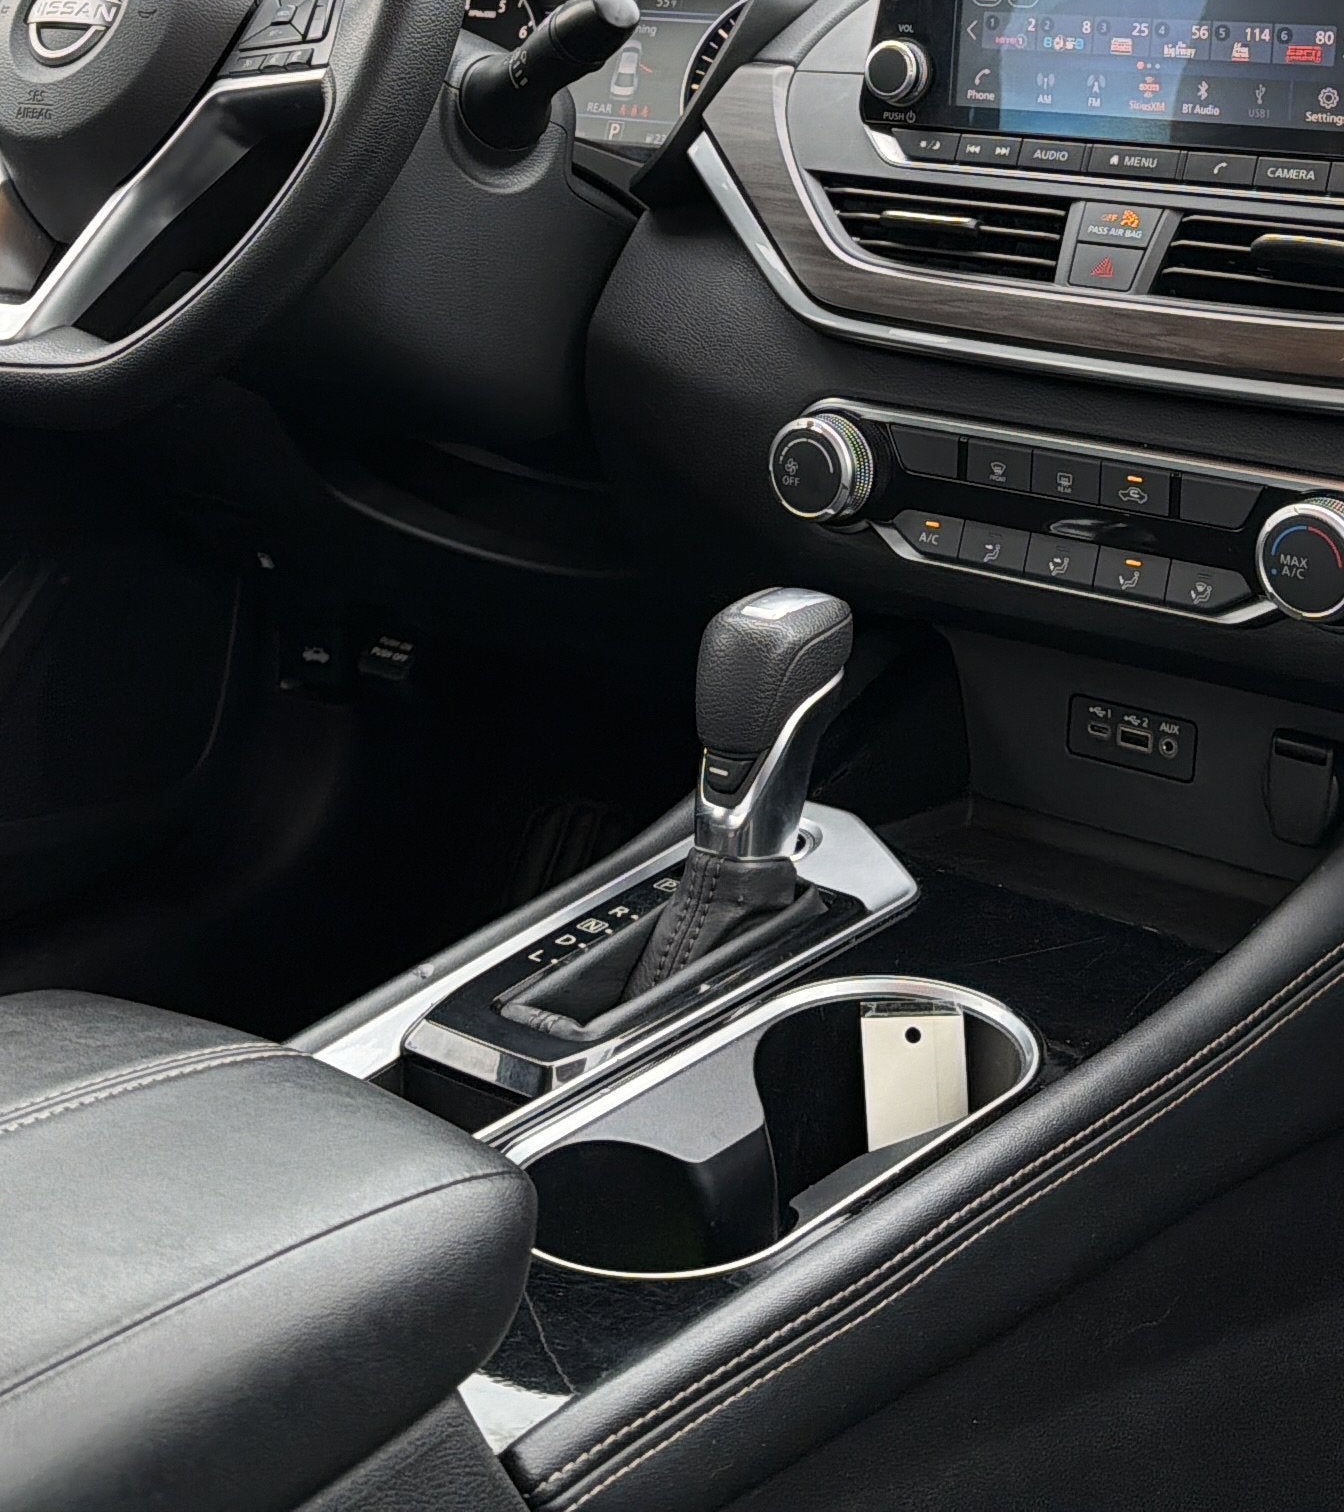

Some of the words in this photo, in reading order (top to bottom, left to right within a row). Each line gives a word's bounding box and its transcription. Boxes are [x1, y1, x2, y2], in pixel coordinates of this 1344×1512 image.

[33, 0, 117, 22] NISSAN
[498, 0, 507, 13] 5
[898, 23, 914, 34] VOL
[1027, 18, 1036, 31] 2
[1082, 20, 1092, 34] 8
[1131, 22, 1149, 37] 25
[518, 25, 528, 38] 6
[1191, 25, 1209, 39] 56
[1245, 27, 1271, 42] 114
[1316, 31, 1335, 45] 80
[967, 89, 995, 101] Phone
[1037, 94, 1052, 104] AM
[586, 102, 613, 114] REAR
[1087, 97, 1100, 107] FM
[1129, 100, 1165, 113] SiriusXM
[883, 111, 905, 122] PUSH
[1182, 104, 1196, 115] BT
[1196, 104, 1220, 117] Audio
[608, 122, 621, 140] P
[1033, 149, 1069, 162] AUDIO
[1123, 156, 1157, 169] MENU
[1267, 167, 1315, 181] CAMERA
[1087, 225, 1109, 235] PASS
[1108, 227, 1125, 237] AIR
[1124, 229, 1143, 239] BAG
[782, 475, 801, 488] OFF
[918, 531, 939, 546] A/C
[1279, 553, 1309, 570] MAX
[1281, 566, 1306, 581] A/C
[1141, 717, 1150, 729] 2
[1159, 721, 1181, 736] AUX
[607, 905, 630, 918] R
[554, 933, 577, 946] D
[527, 949, 545, 963] L
